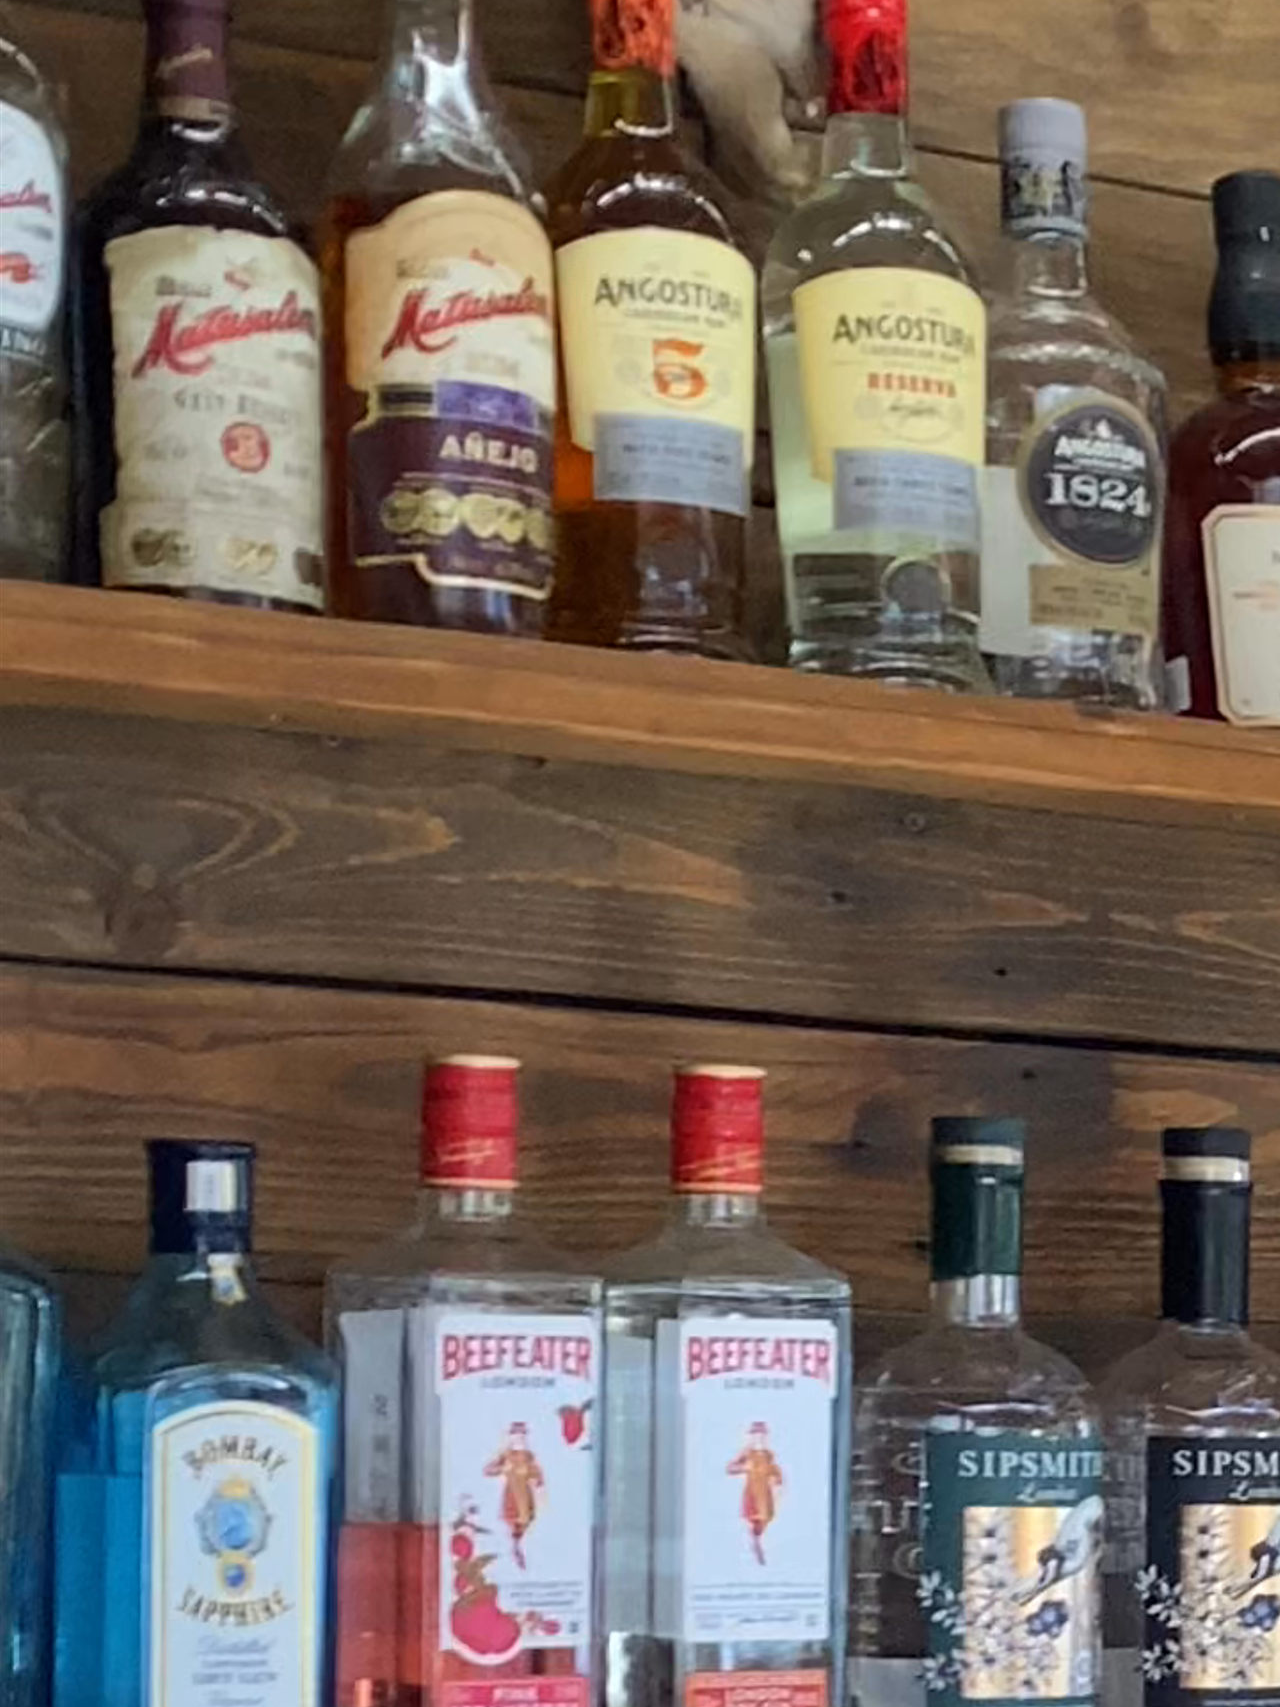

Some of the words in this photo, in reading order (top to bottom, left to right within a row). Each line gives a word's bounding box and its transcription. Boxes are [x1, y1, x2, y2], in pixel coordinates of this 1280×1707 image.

[594, 276, 744, 321] ANGOSTURA
[831, 313, 976, 361] ANGOSTURA
[649, 339, 707, 400] 5
[1043, 472, 1153, 519] 1824
[440, 1333, 591, 1381] BEEFEATER
[688, 1336, 831, 1385] BEEFEATER
[179, 1435, 290, 1480] BOMBAY
[175, 1587, 295, 1630] SAPPHIRE
